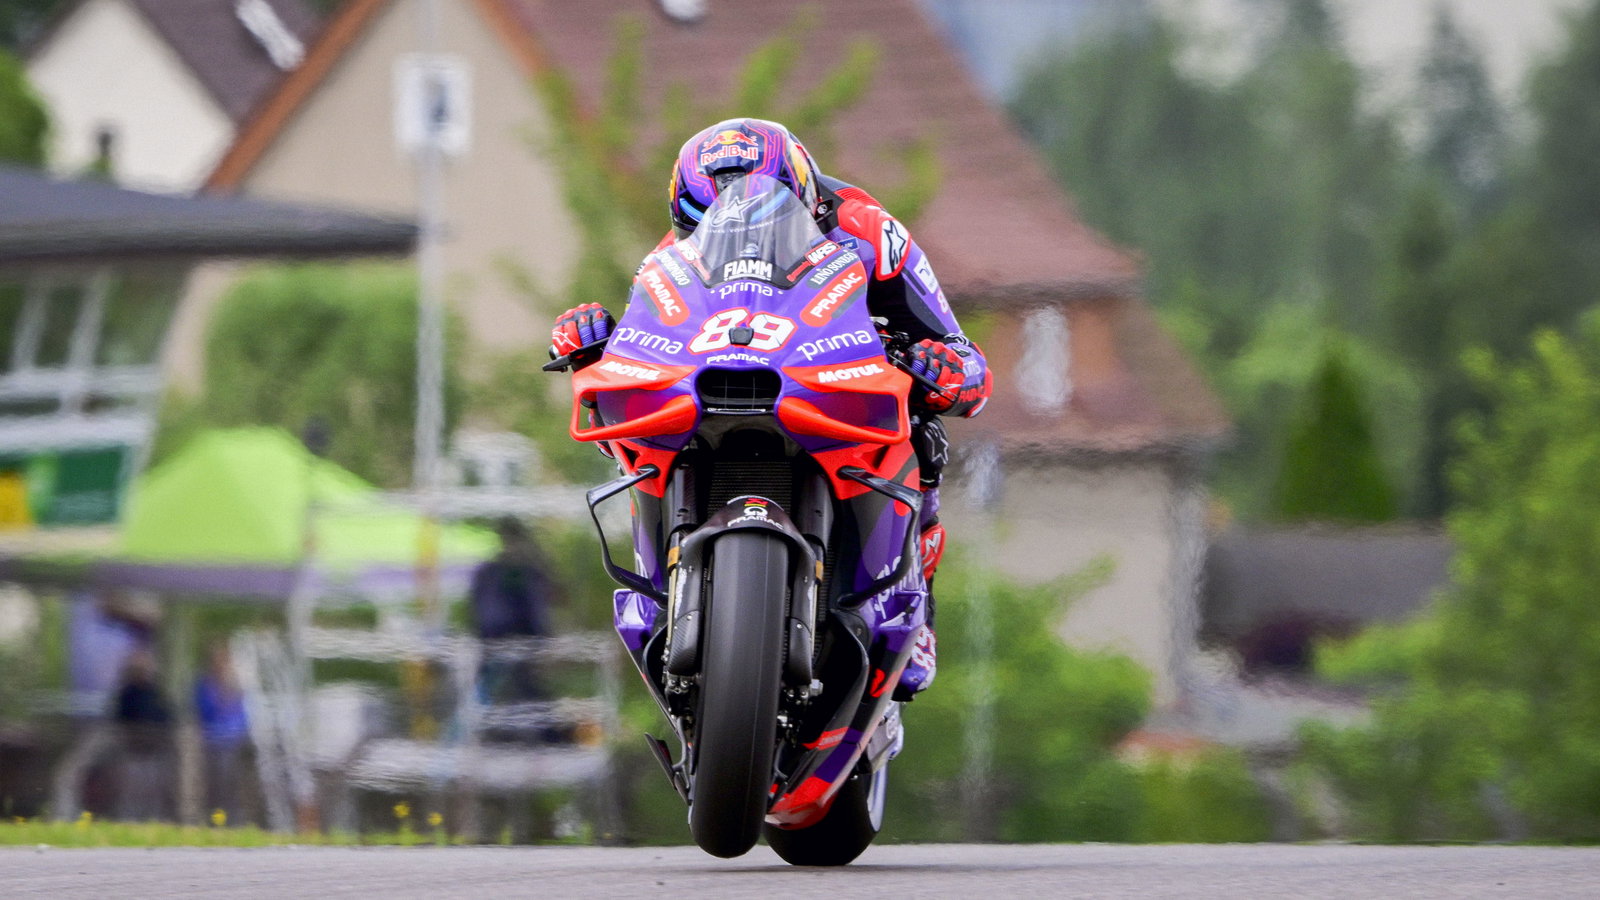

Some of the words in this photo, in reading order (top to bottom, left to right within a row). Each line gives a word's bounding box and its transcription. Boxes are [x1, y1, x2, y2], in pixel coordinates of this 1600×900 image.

[701, 146, 727, 166] Red
[728, 145, 759, 161] Bull
[723, 259, 773, 281] FIAMM
[718, 282, 774, 300] prima
[810, 272, 864, 318] PRAMAC
[613, 327, 684, 355] prima
[687, 307, 797, 355] 89
[796, 330, 873, 361] prima
[706, 352, 771, 366] PRAMAC
[599, 361, 661, 381] MOTUL
[818, 363, 885, 384] MOTUL
[727, 516, 784, 530] PRAMAC
